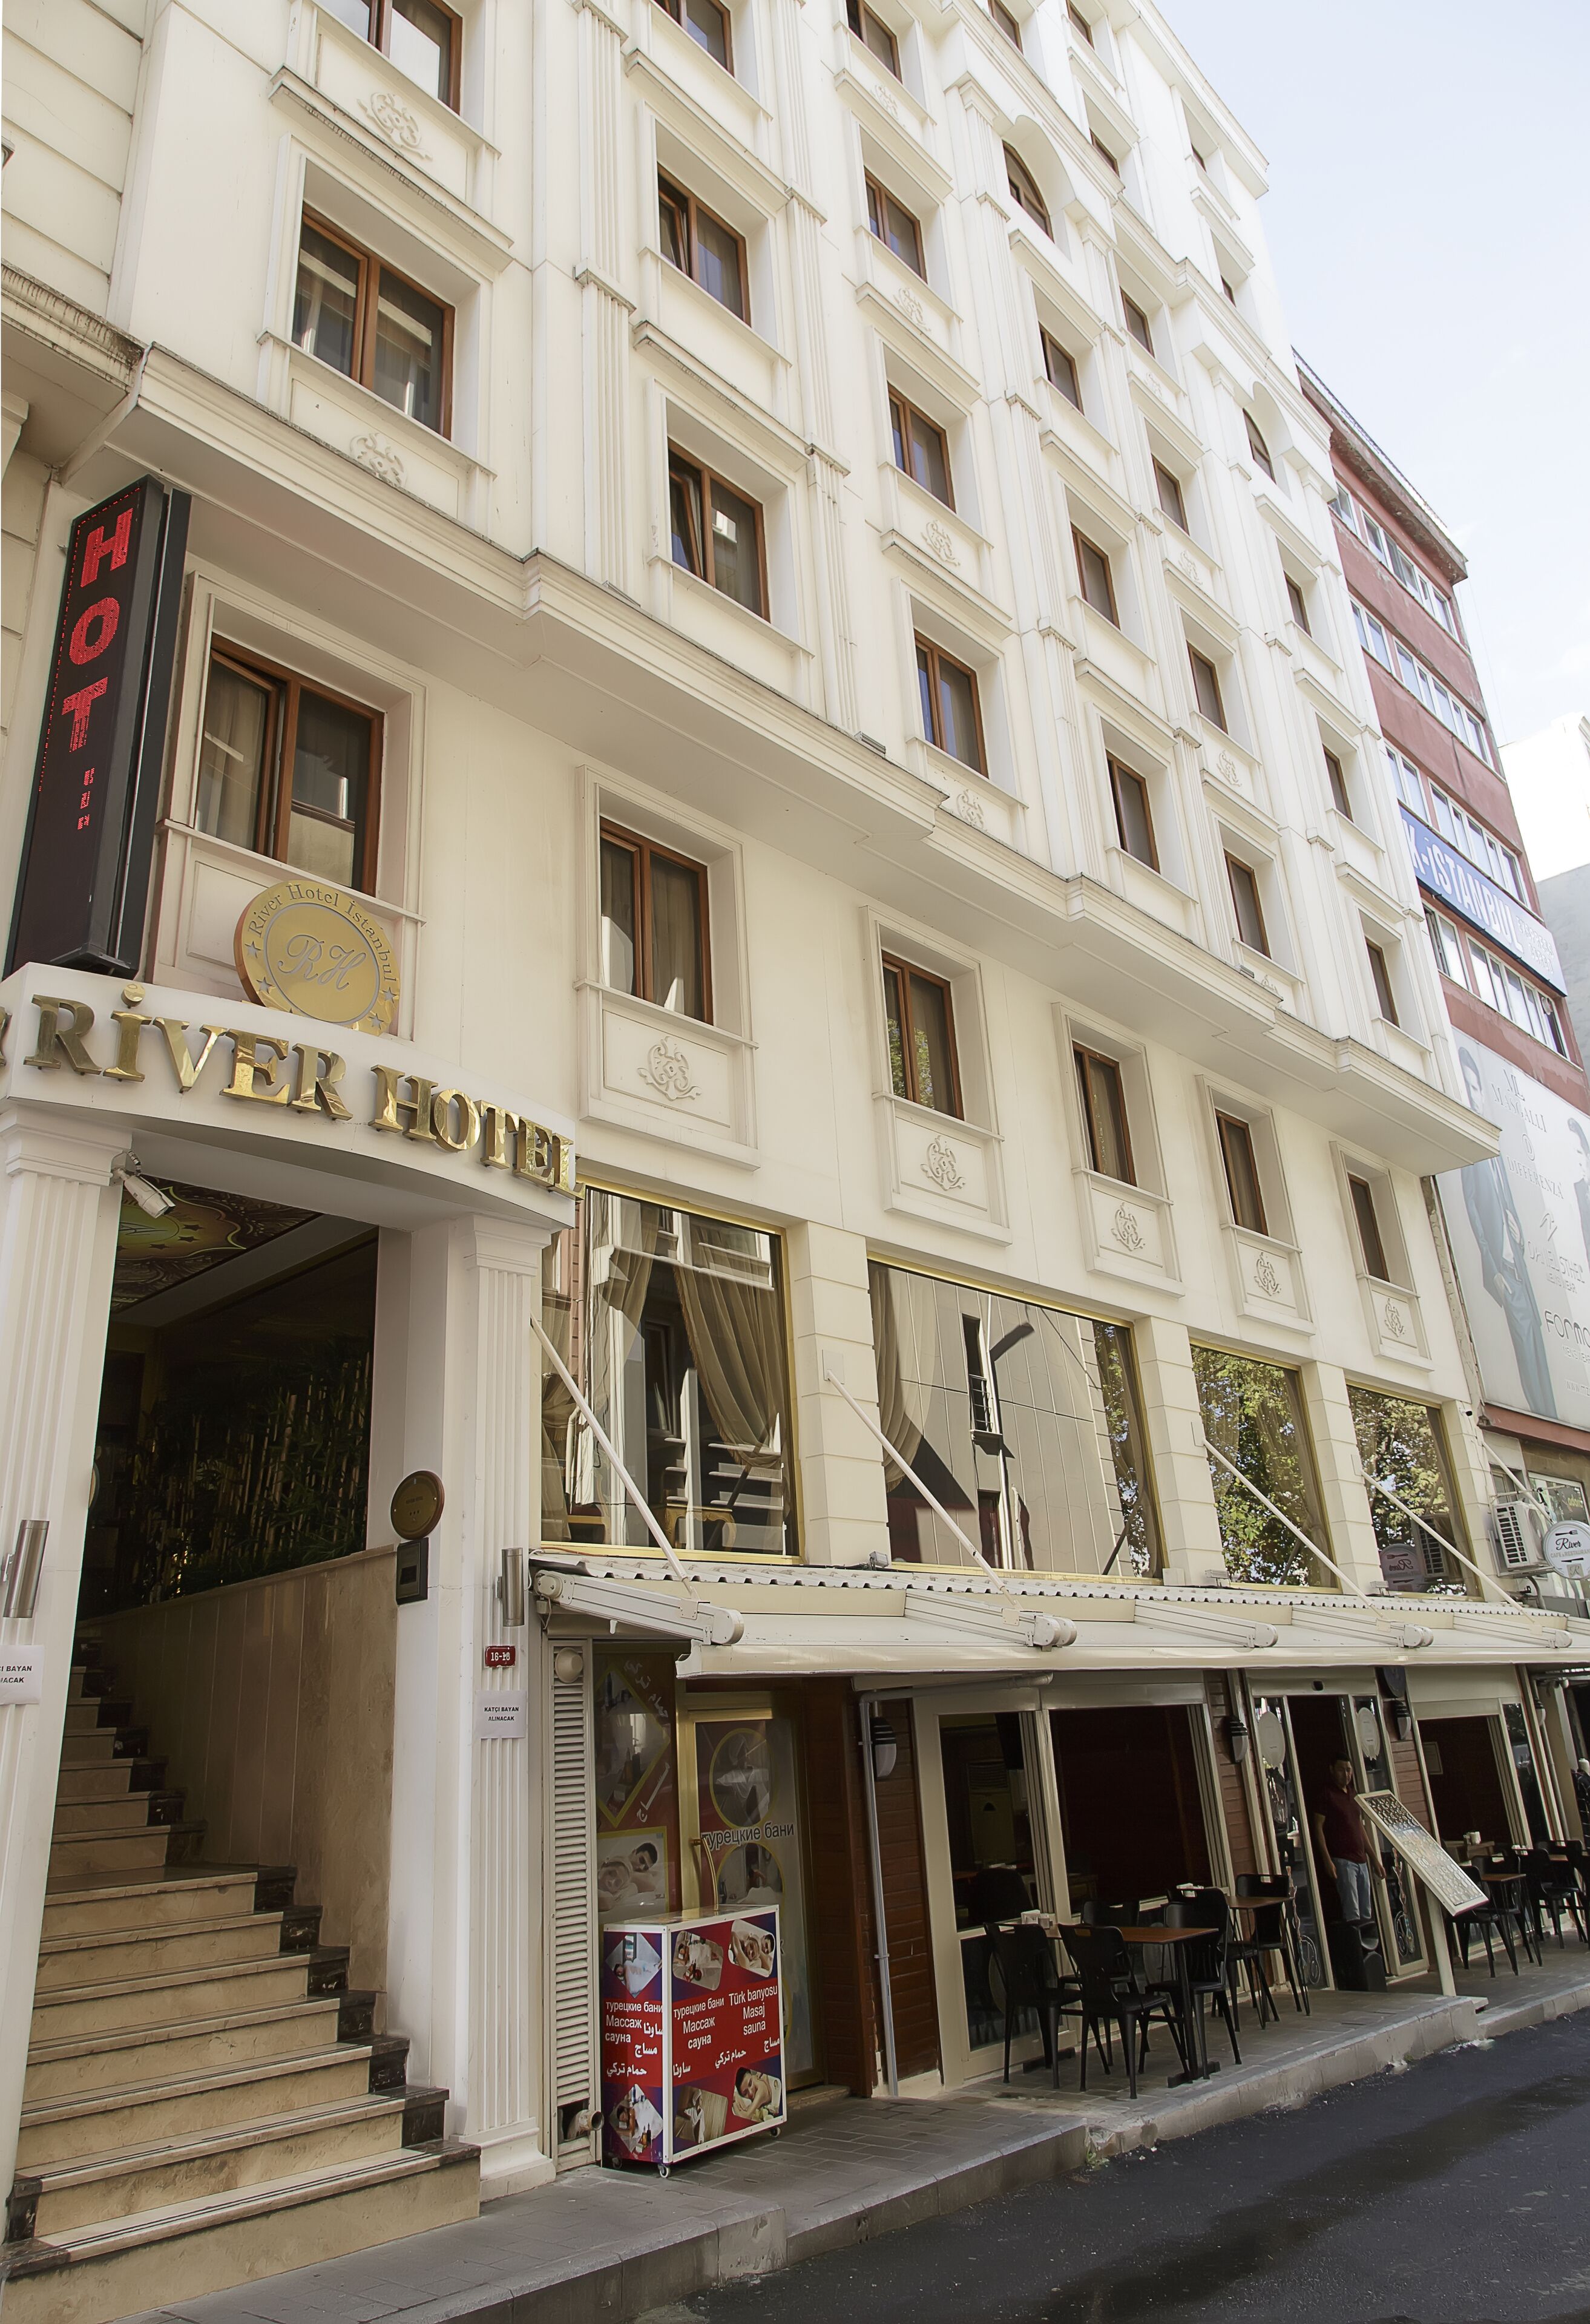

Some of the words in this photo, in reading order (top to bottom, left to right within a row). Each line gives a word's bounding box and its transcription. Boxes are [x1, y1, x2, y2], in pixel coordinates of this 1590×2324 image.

[248, 894, 283, 937] River
[286, 884, 339, 907] Hotel
[368, 1064, 585, 1201] HOTEL
[1556, 1538, 1582, 1551] River
[764, 1822, 795, 1839] бани
[729, 1991, 746, 2006] Türk
[747, 1985, 778, 2001] banyosu
[606, 2001, 642, 2012] турецкие
[673, 2002, 706, 2020] турецкие
[708, 1997, 724, 2010] бани
[743, 2002, 765, 2020] Masaj
[606, 2015, 642, 2029] Массаж
[683, 2017, 715, 2034] Массаж
[743, 2020, 766, 2035] sauna
[605, 2032, 631, 2044] сауна
[688, 2034, 712, 2049] сауна
[634, 2042, 658, 2058] مساج
[731, 2049, 746, 2063] حمام
[715, 2050, 731, 2069] تركي
[606, 2062, 626, 2077] تركي
[626, 2064, 647, 2077] حمام
[672, 2061, 691, 2078] ساونا
